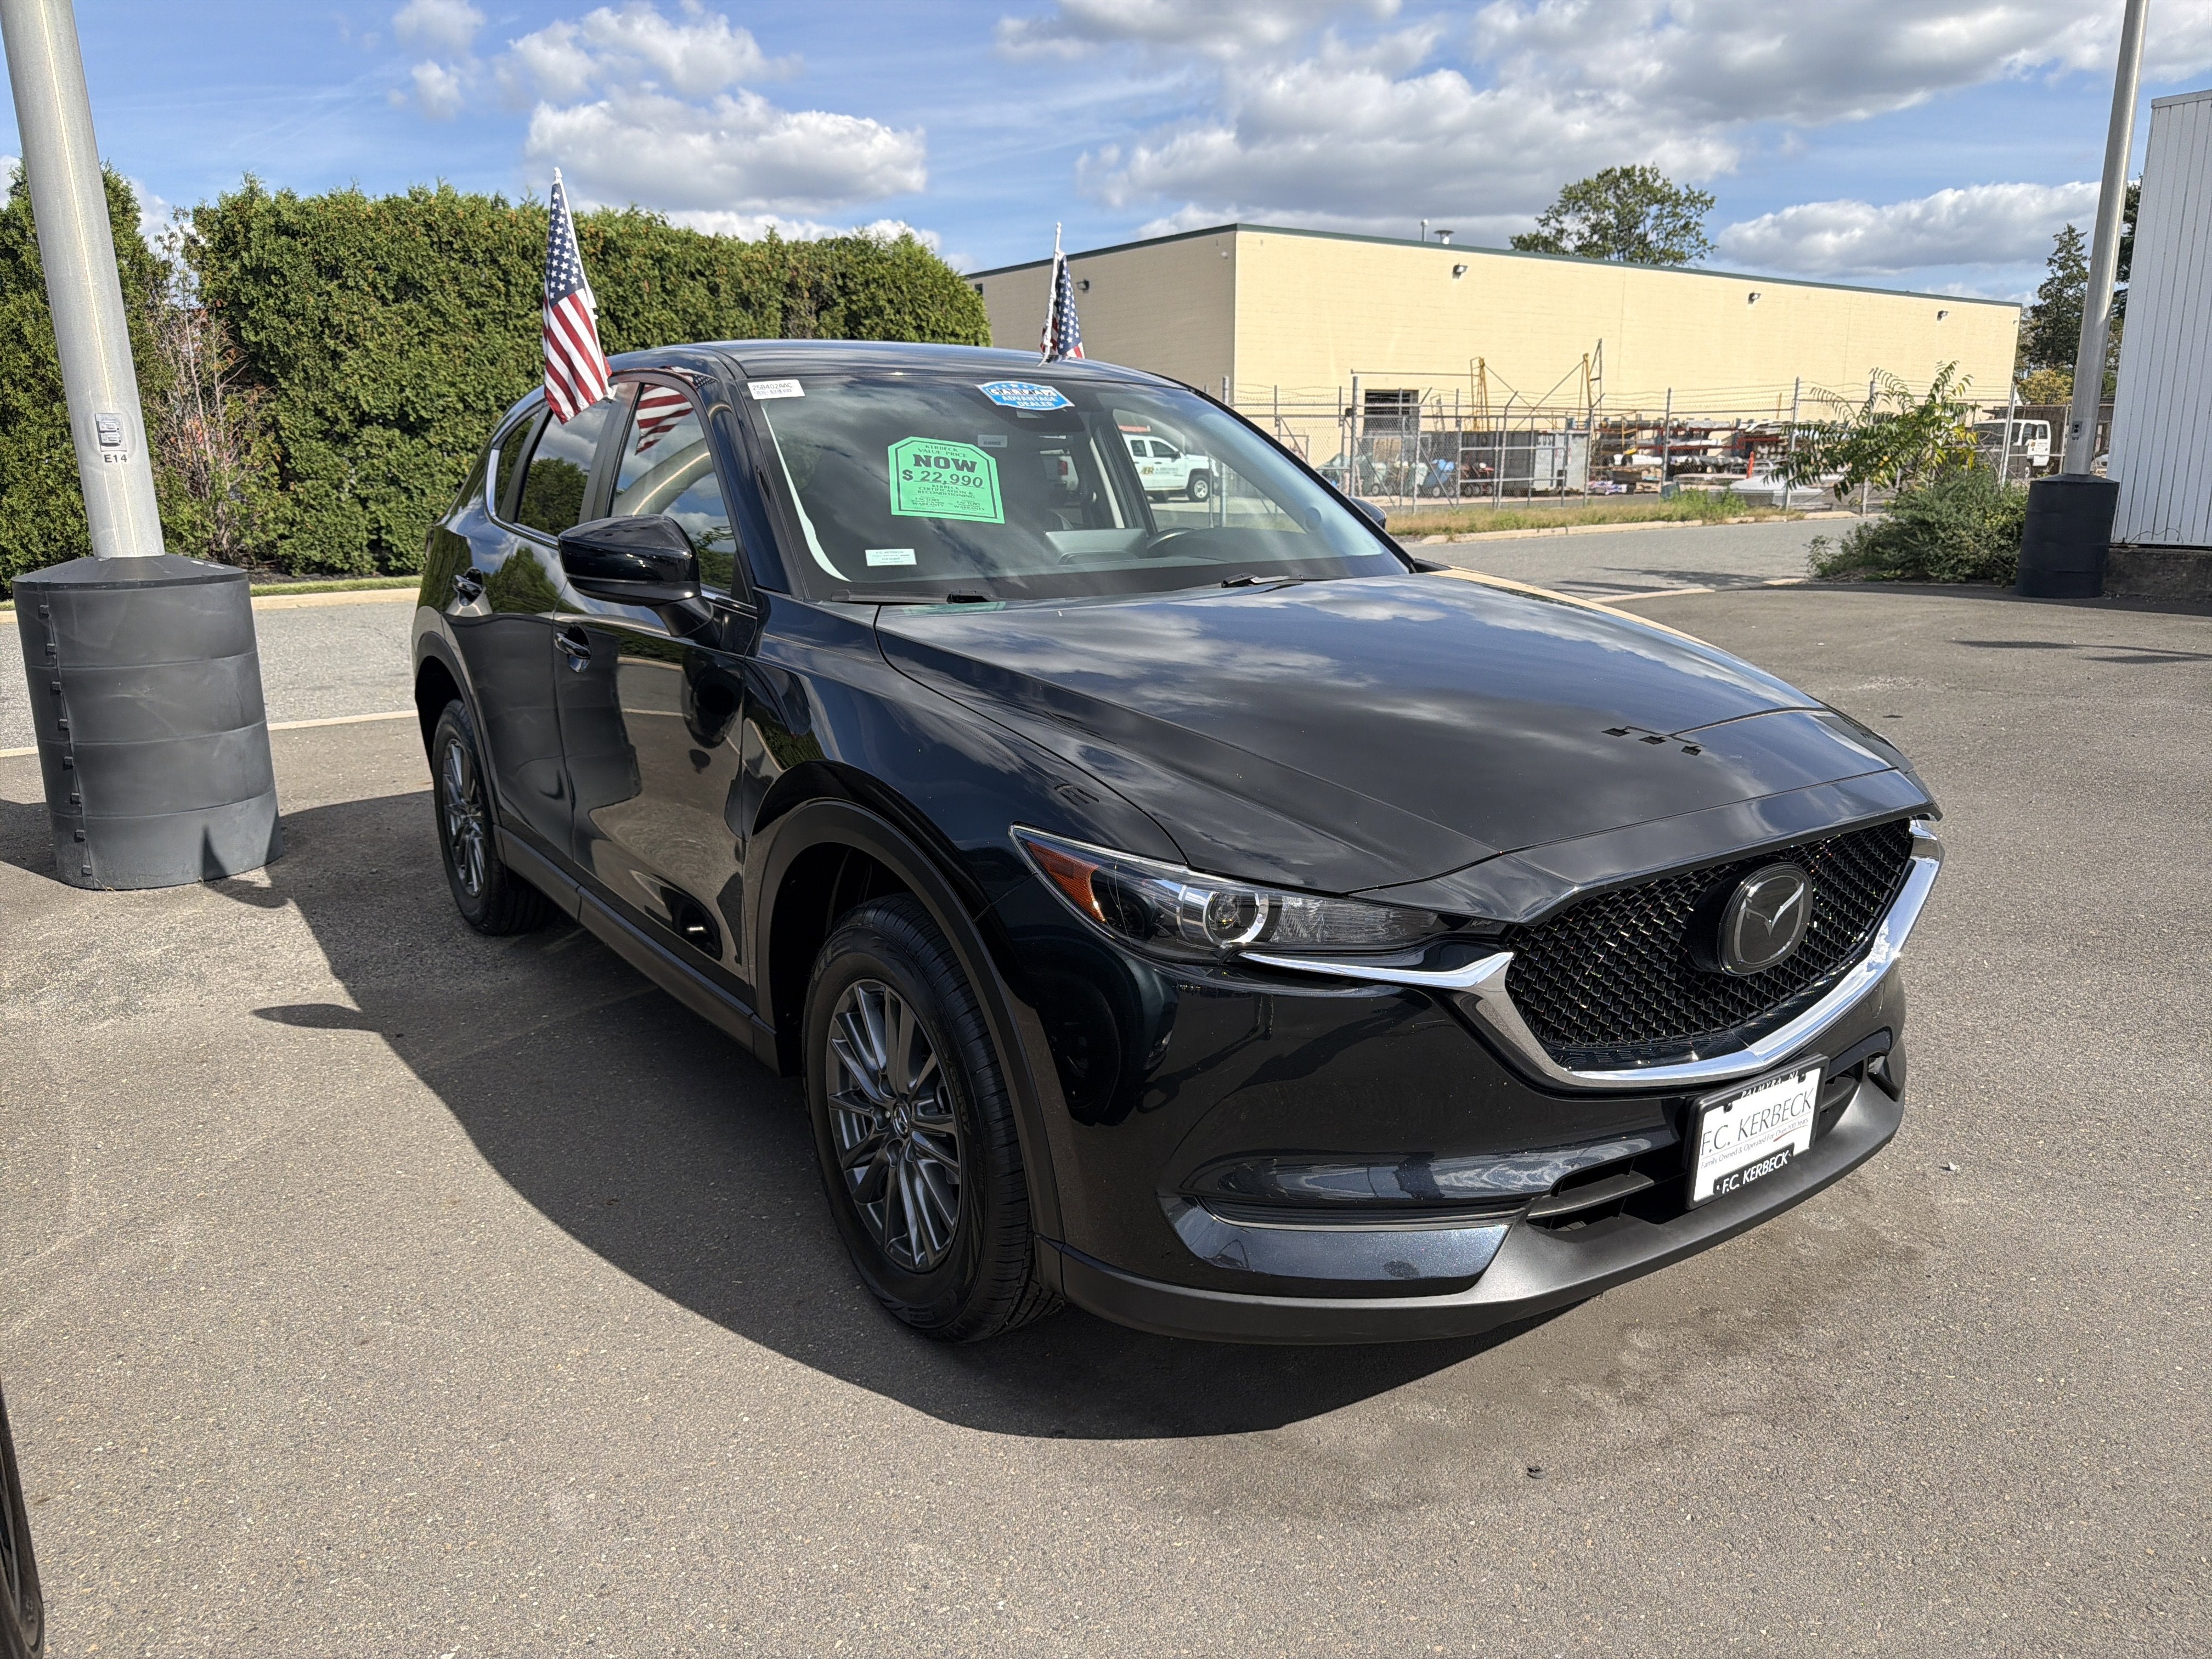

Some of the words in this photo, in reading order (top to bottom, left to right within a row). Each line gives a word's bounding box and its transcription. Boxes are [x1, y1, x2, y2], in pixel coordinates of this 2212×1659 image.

[925, 444, 958, 453] KERBECK
[104, 454, 128, 463] E14
[912, 454, 978, 473] NOW
[902, 469, 914, 482] $
[919, 470, 984, 488] 22,990
[1701, 1125, 1731, 1156] F.C.
[1738, 1087, 1814, 1142] KERBECK
[1722, 1173, 1740, 1194] F.C.
[1742, 1149, 1790, 1185] KERBECK
